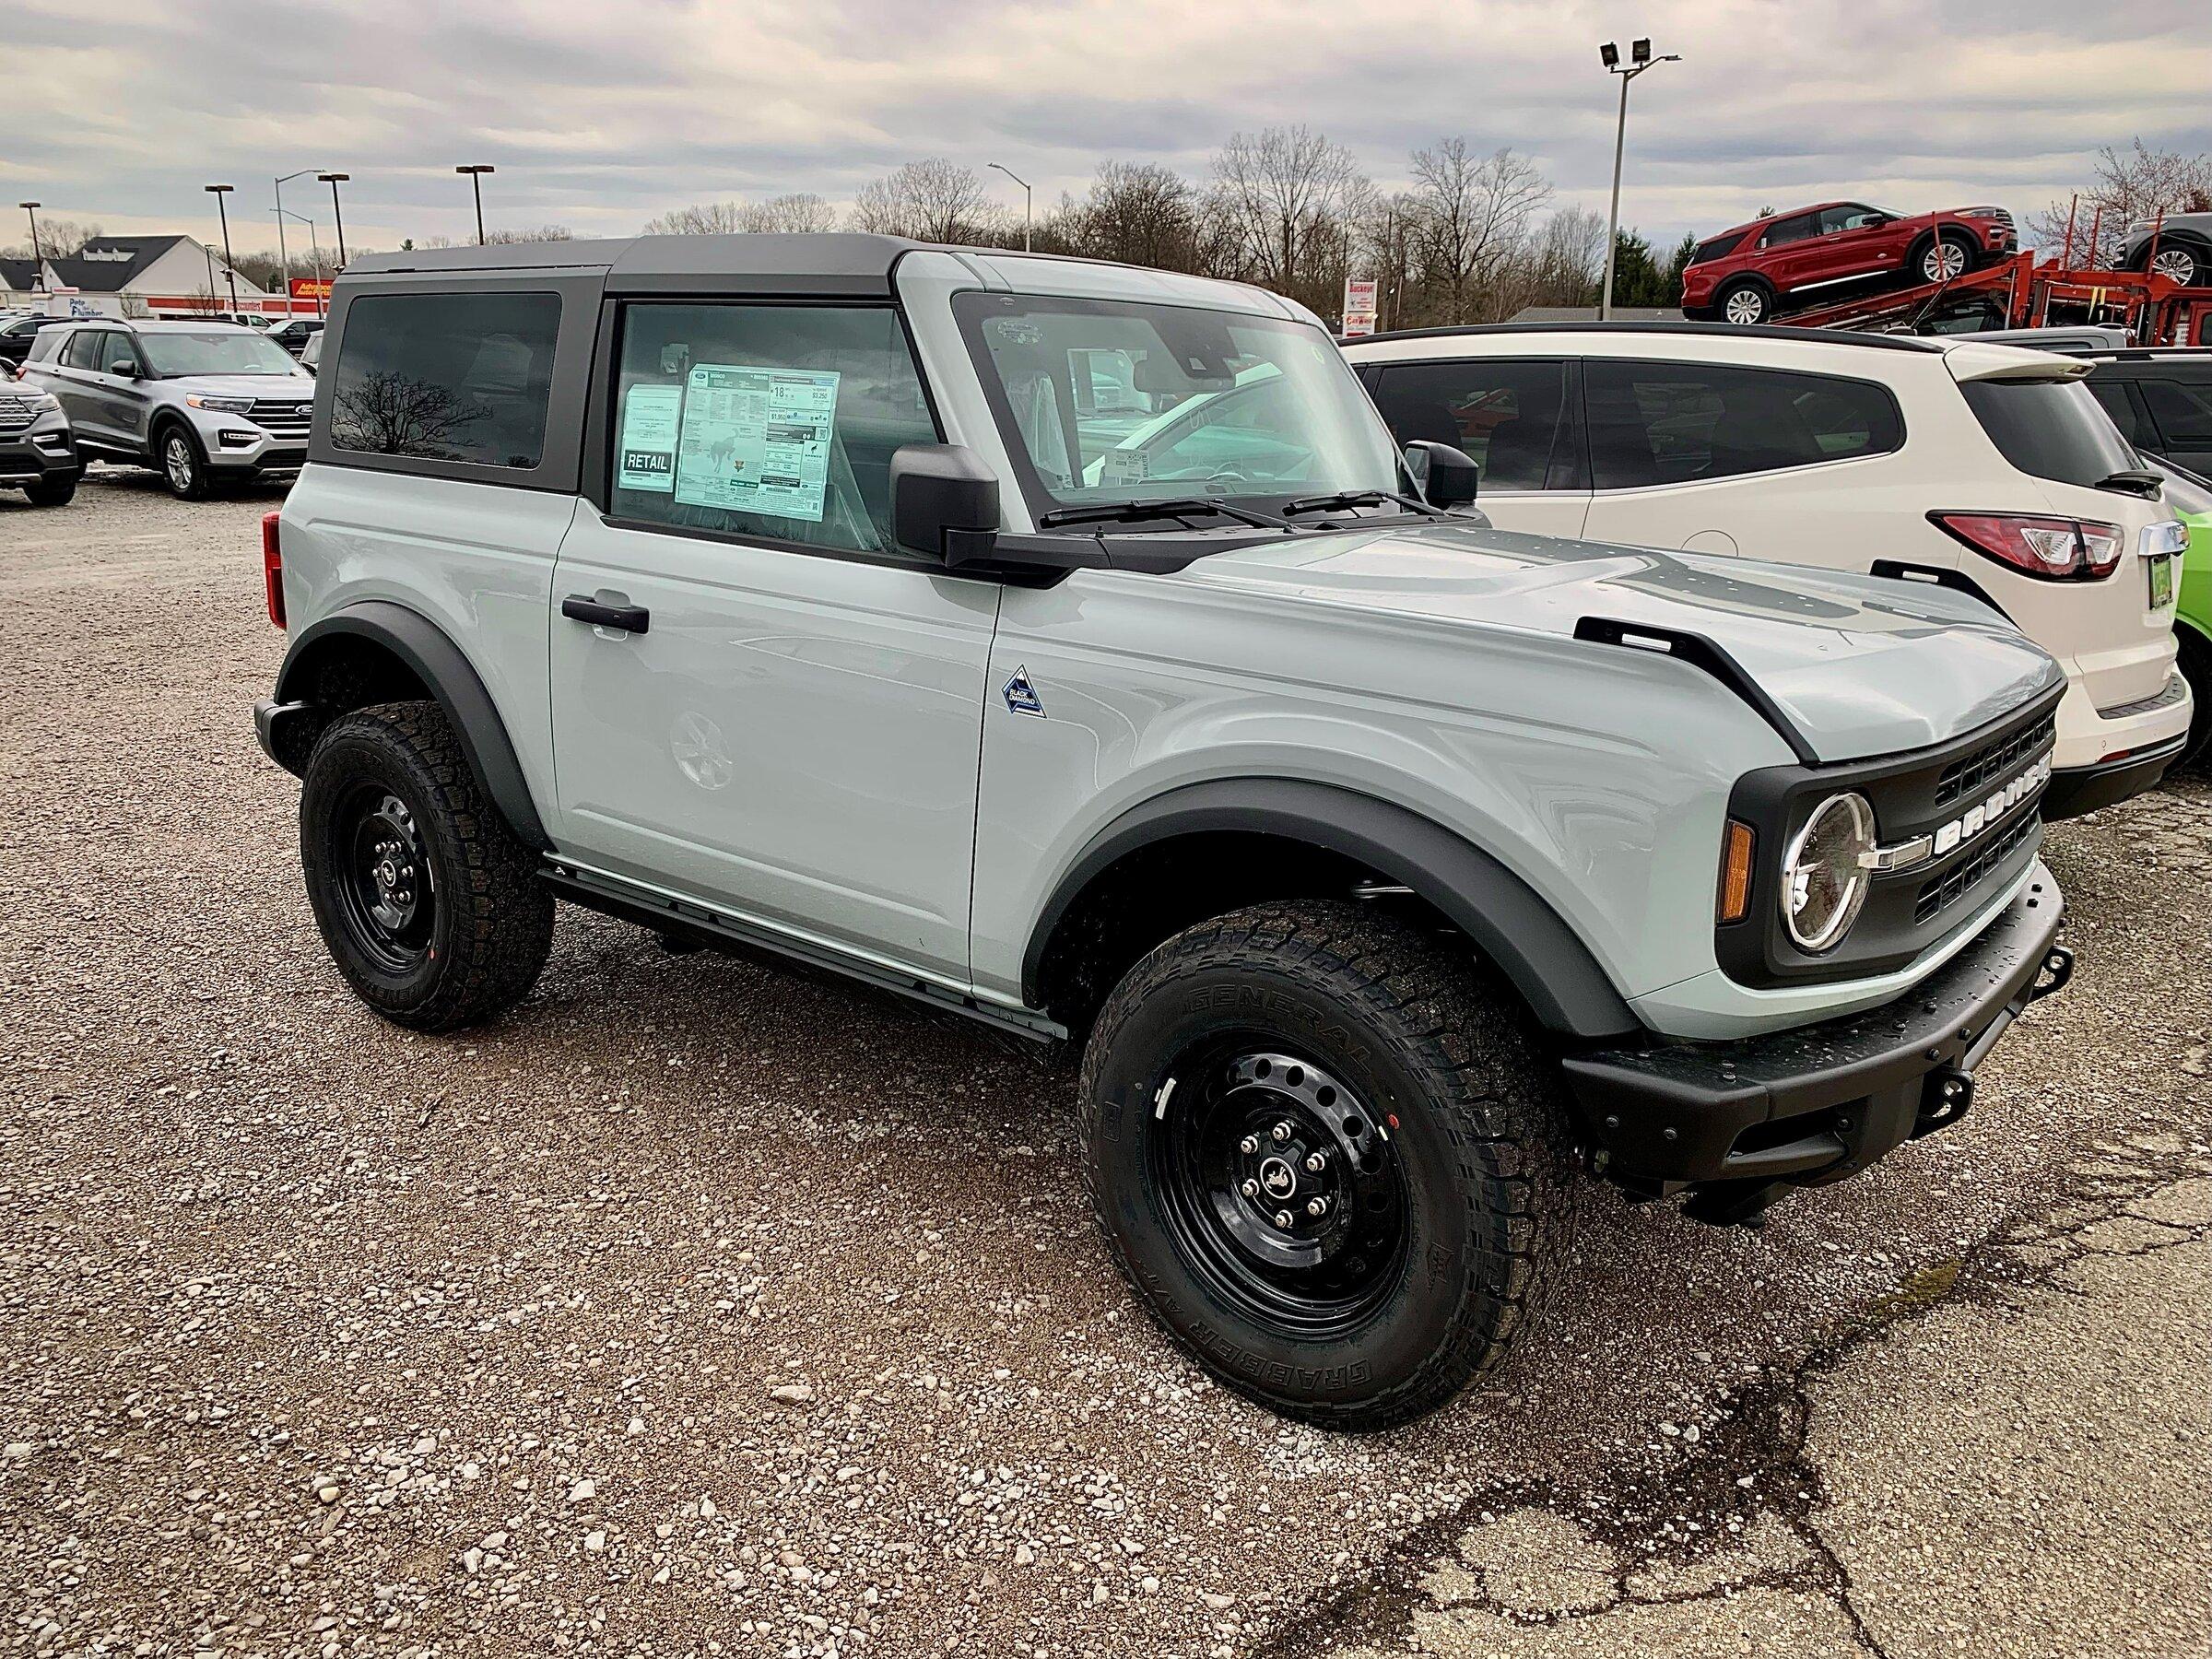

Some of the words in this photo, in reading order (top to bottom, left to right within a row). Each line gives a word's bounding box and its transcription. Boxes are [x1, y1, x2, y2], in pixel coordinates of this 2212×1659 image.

[774, 386, 784, 397] 18
[628, 453, 667, 470] RETAIL
[1008, 694, 1036, 705] DIAMOND
[1009, 688, 1029, 697] BLACK
[1188, 982, 1374, 1076] GENERAL
[1188, 1320, 1373, 1392] GRABBER
